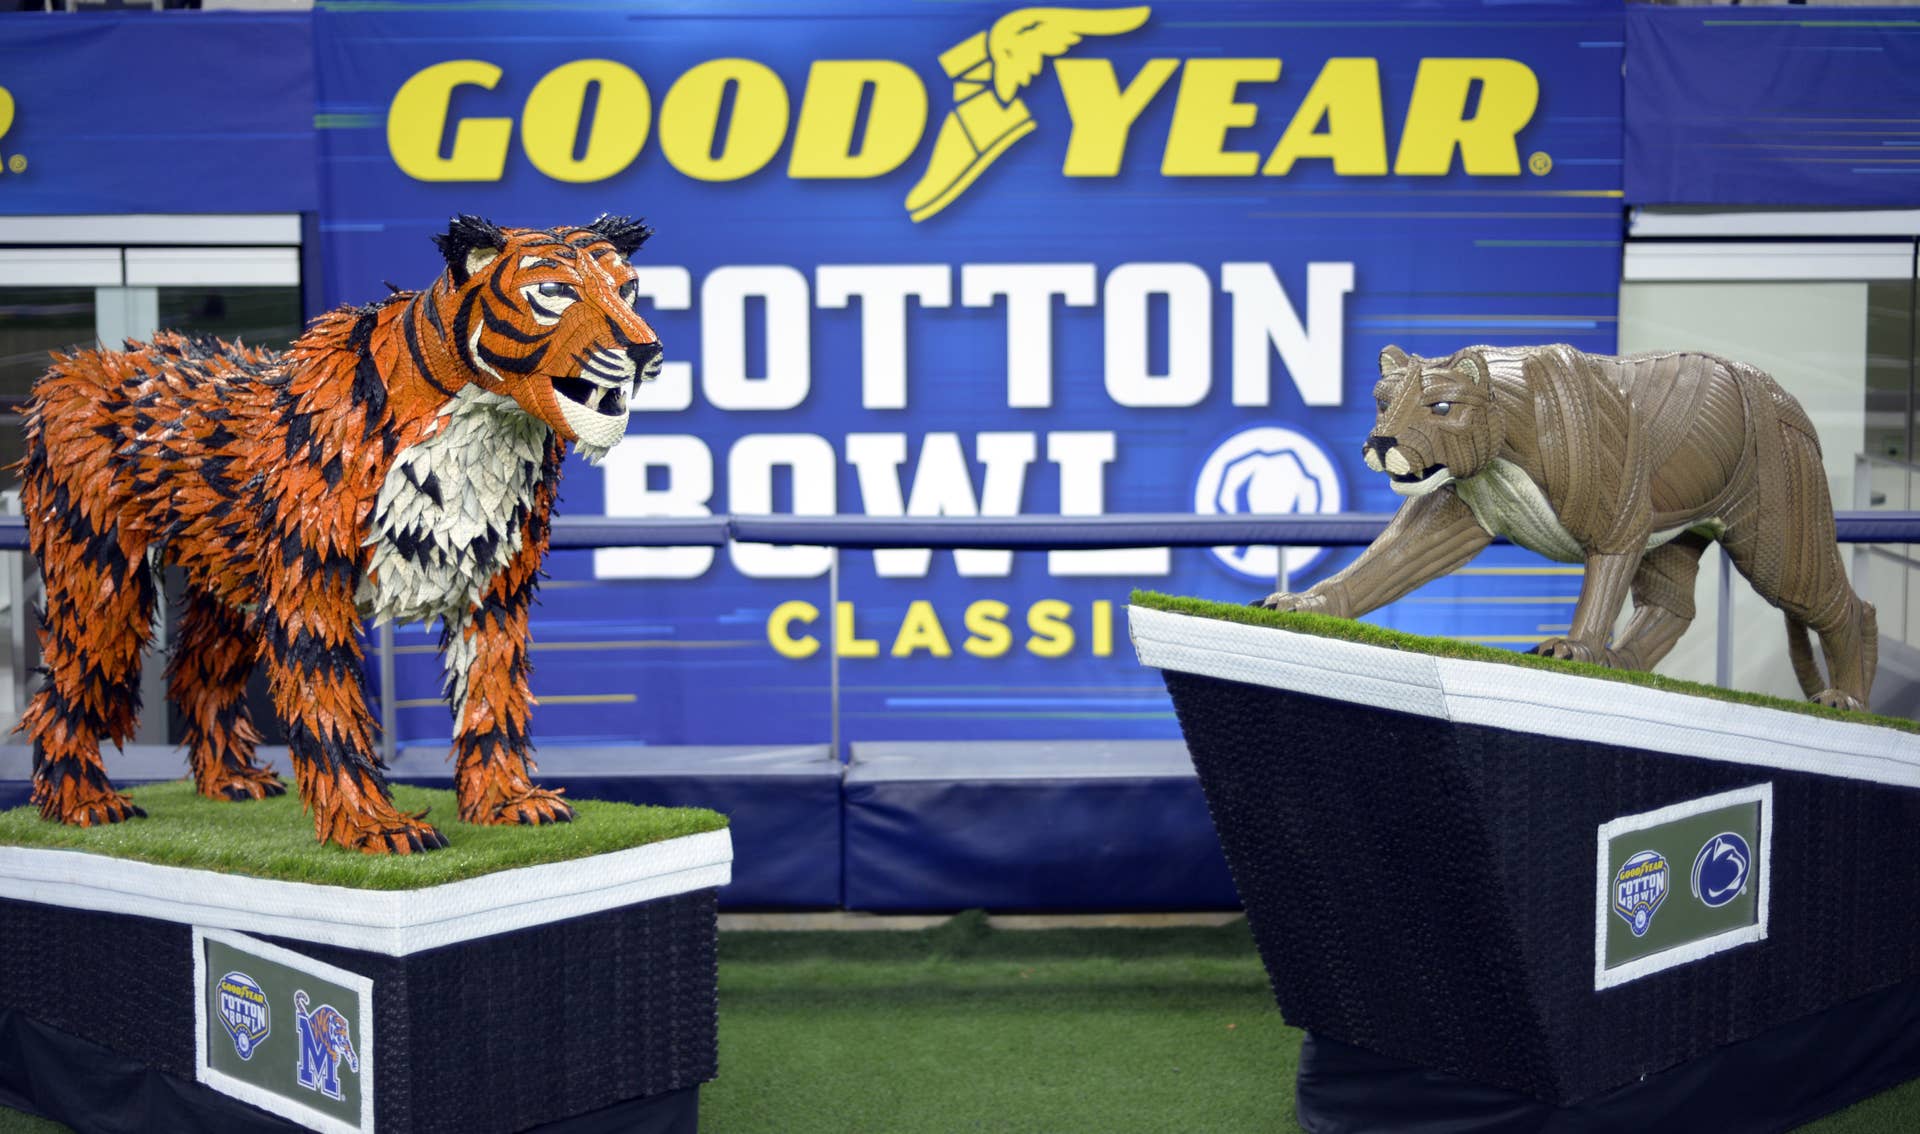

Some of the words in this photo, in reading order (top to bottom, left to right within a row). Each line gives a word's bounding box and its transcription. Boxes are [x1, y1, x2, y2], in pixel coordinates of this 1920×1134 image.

[387, 57, 1540, 183] GOODYEAR
[594, 432, 1171, 580] BOWL
[766, 599, 1113, 659] CLASSI
[1618, 870, 1665, 907] COTTON
[1620, 861, 1664, 881] GOODYEAR
[1626, 889, 1656, 910] BOWL
[220, 991, 266, 1030] COTTON
[221, 981, 265, 1003] GOODYEAR
[229, 1009, 259, 1034] BOWL
[296, 1013, 340, 1100] M
